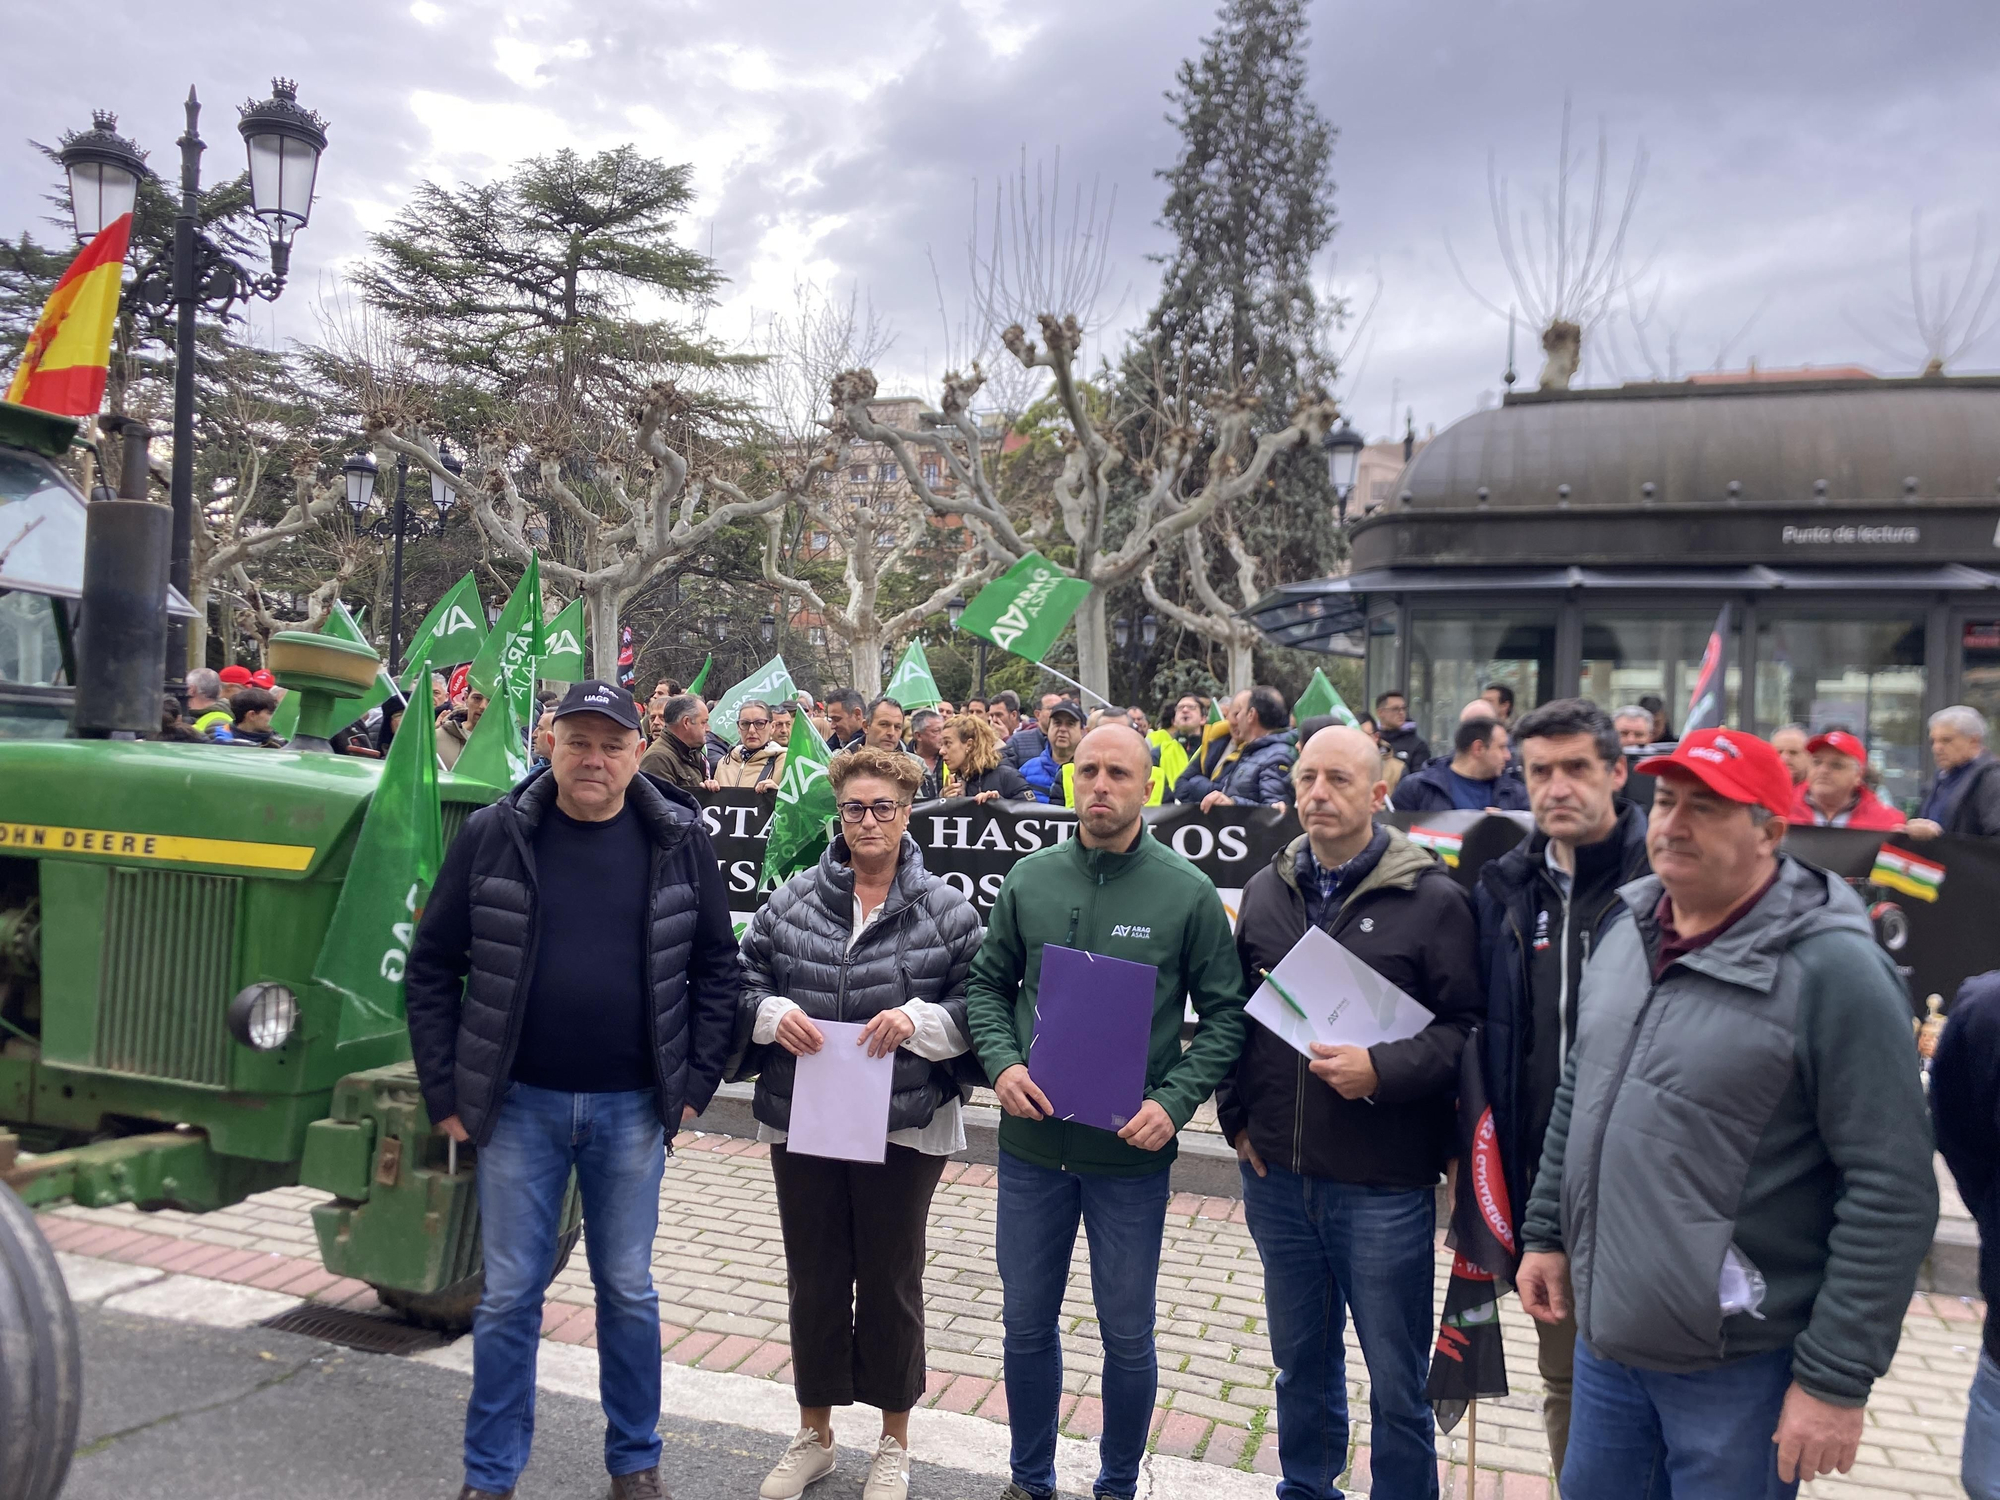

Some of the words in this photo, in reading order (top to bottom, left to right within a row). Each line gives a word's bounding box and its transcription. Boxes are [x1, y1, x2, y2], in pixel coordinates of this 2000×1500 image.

[1782, 525, 1833, 544] Punto
[1833, 524, 1857, 543] de
[584, 694, 610, 704] UAGR
[63, 831, 157, 854] DEERE
[928, 815, 1079, 852] HAST
[1147, 824, 1249, 862] OS
[1130, 931, 1150, 939] ASAJA
[1131, 925, 1151, 933] ARAG
